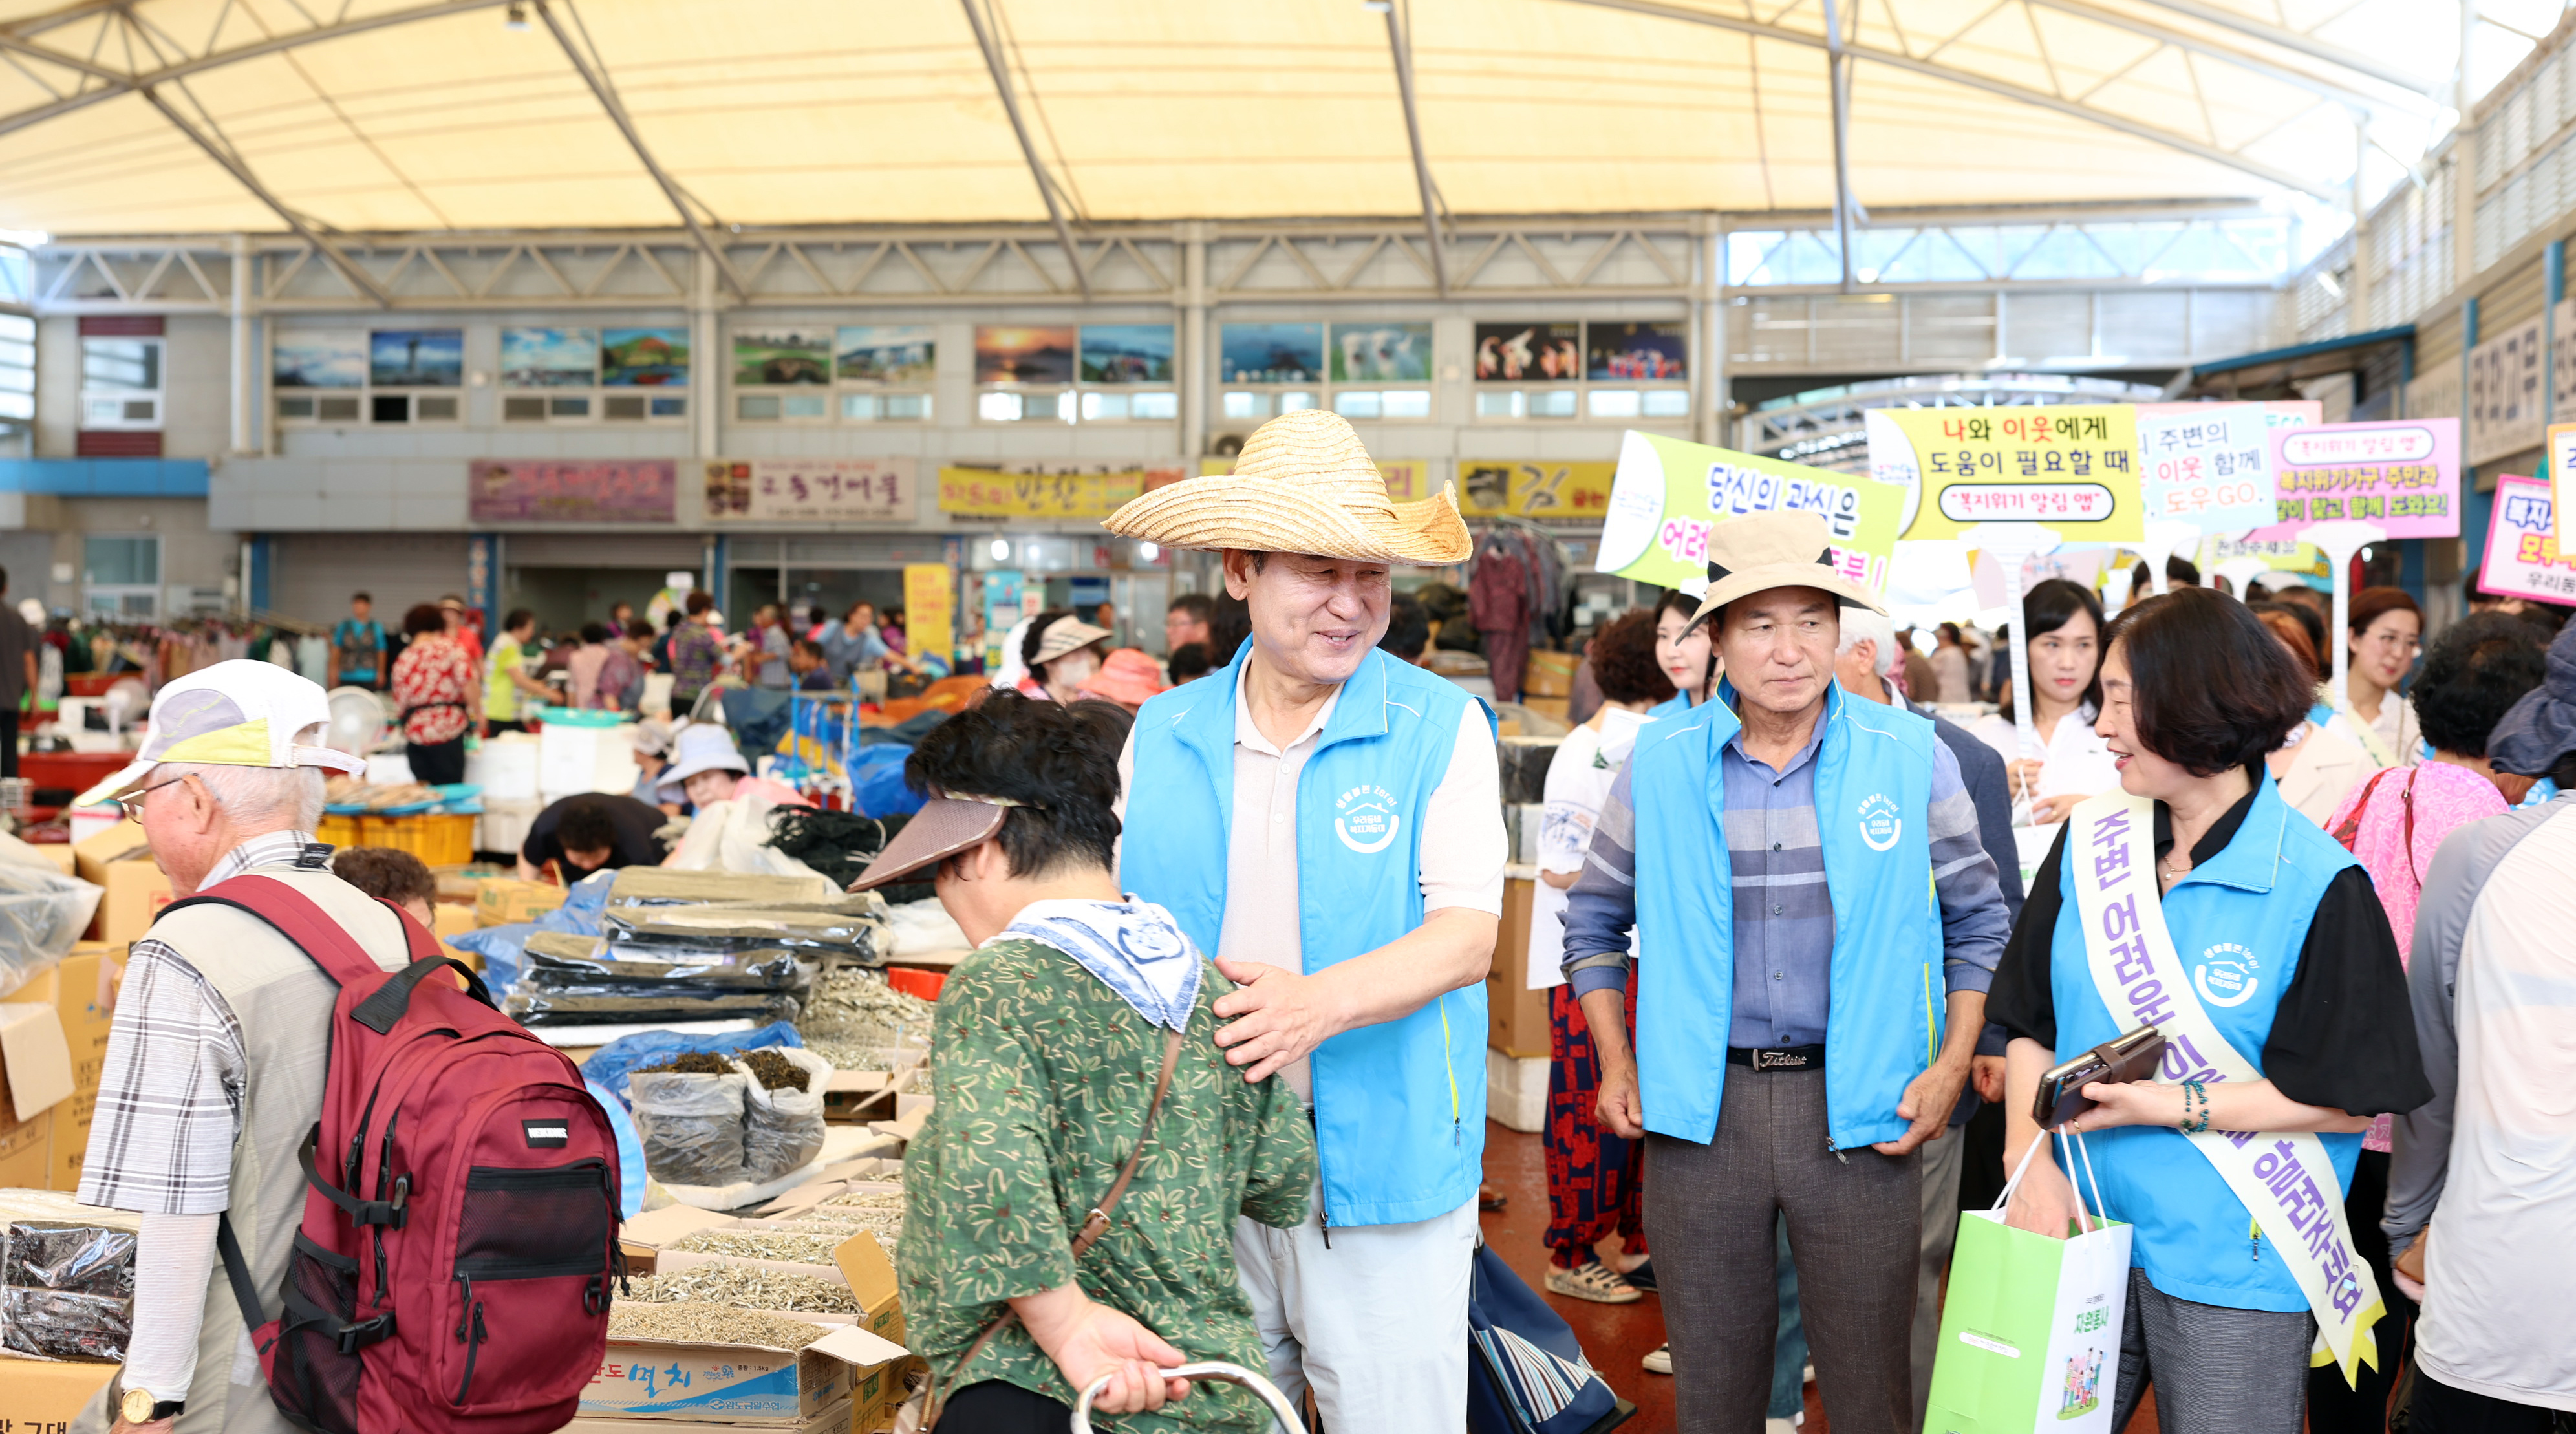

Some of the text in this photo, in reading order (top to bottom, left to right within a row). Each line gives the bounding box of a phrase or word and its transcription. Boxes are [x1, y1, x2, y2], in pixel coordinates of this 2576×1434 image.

[1944, 416, 2108, 442] 나와 이웃에게
[2159, 421, 2227, 452] 주변의
[1930, 451, 2003, 476] 도움이
[2016, 449, 2093, 476] 필요할
[2105, 450, 2129, 473] 때
[2158, 448, 2260, 482] 이웃 함께
[1710, 466, 1779, 515] 당신의
[2280, 464, 2439, 493] 복지위기가구 주민과
[2030, 492, 2068, 514] 알림
[2350, 495, 2385, 520] 함께
[2389, 493, 2448, 518] 도와요!
[2092, 808, 2176, 1027] 주변 어려운
[1759, 1052, 1807, 1068] Titleist
[2253, 1139, 2363, 1325] 알려주세요
[627, 1362, 691, 1399] 멸치
